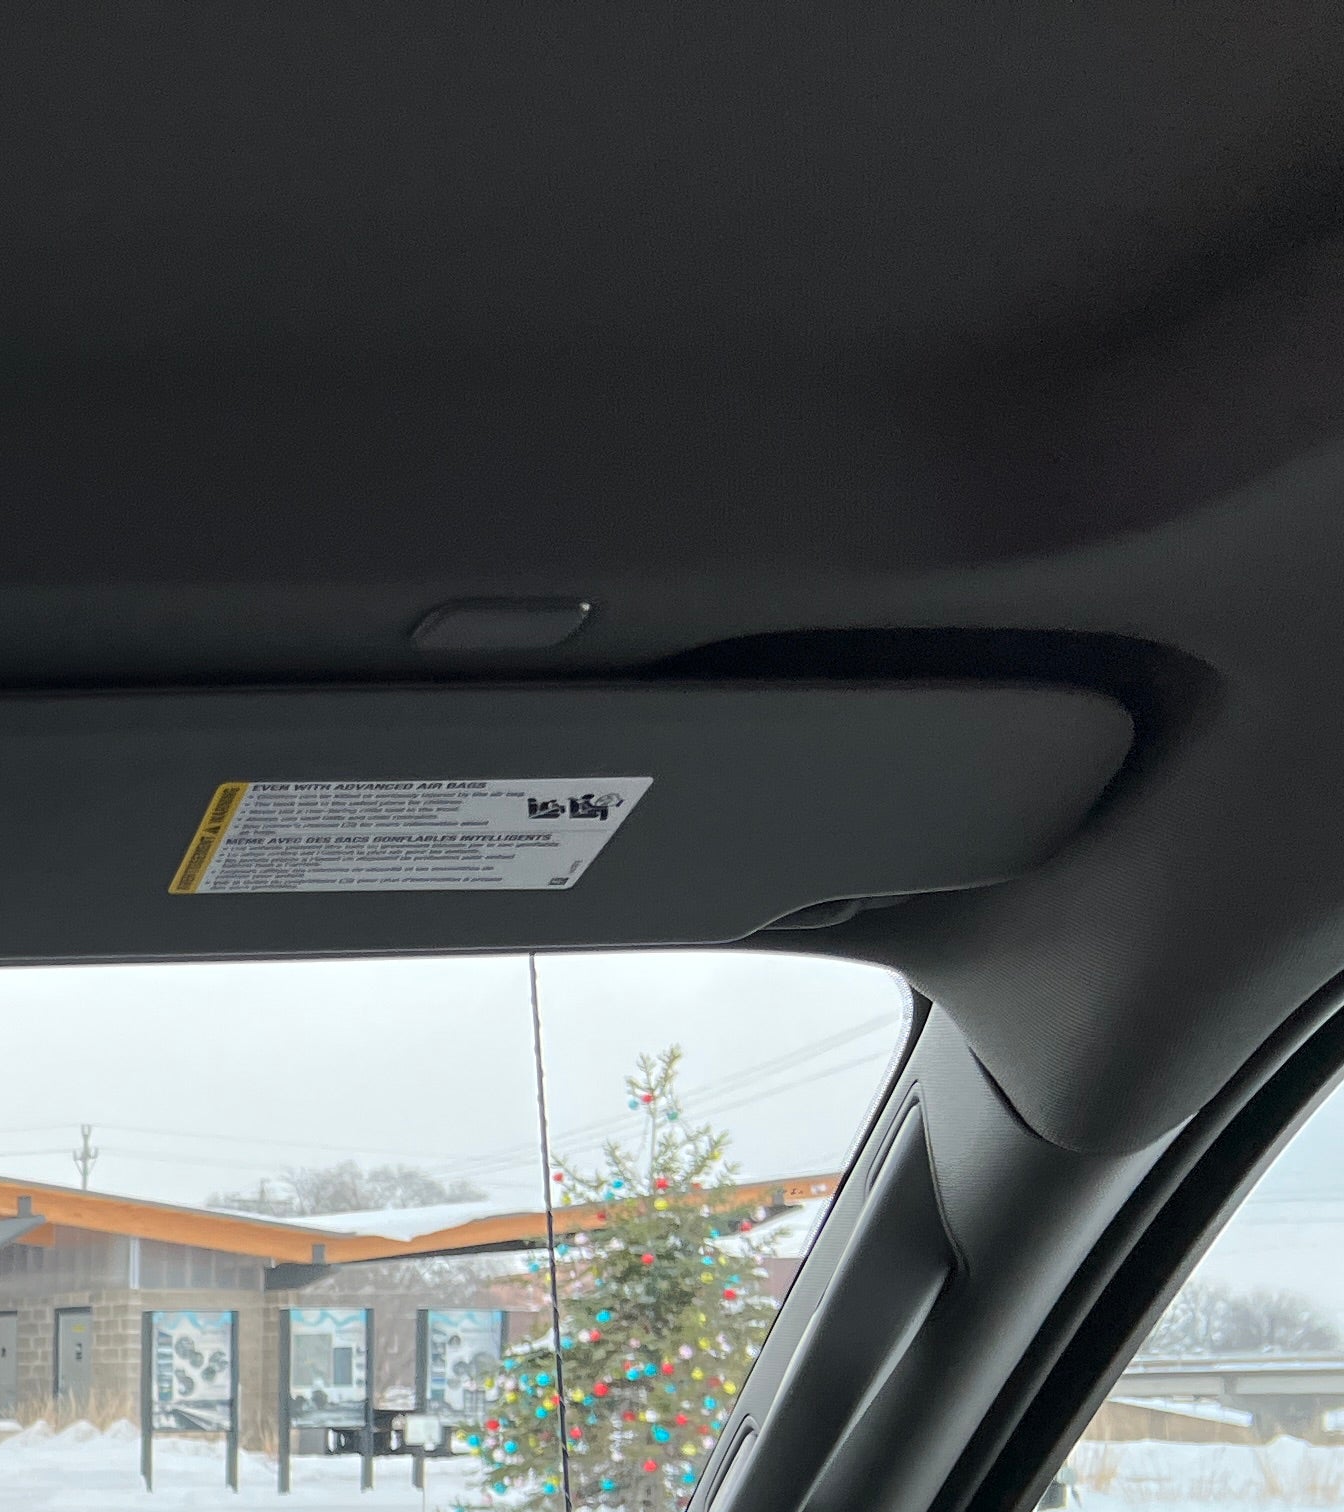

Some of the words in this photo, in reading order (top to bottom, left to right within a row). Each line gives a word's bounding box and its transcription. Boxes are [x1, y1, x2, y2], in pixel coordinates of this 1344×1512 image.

[252, 783, 292, 792] EVEN
[294, 783, 331, 792] WITH
[334, 782, 414, 791] ADVANCED
[415, 782, 444, 790] AIR
[447, 782, 487, 790] BAGS
